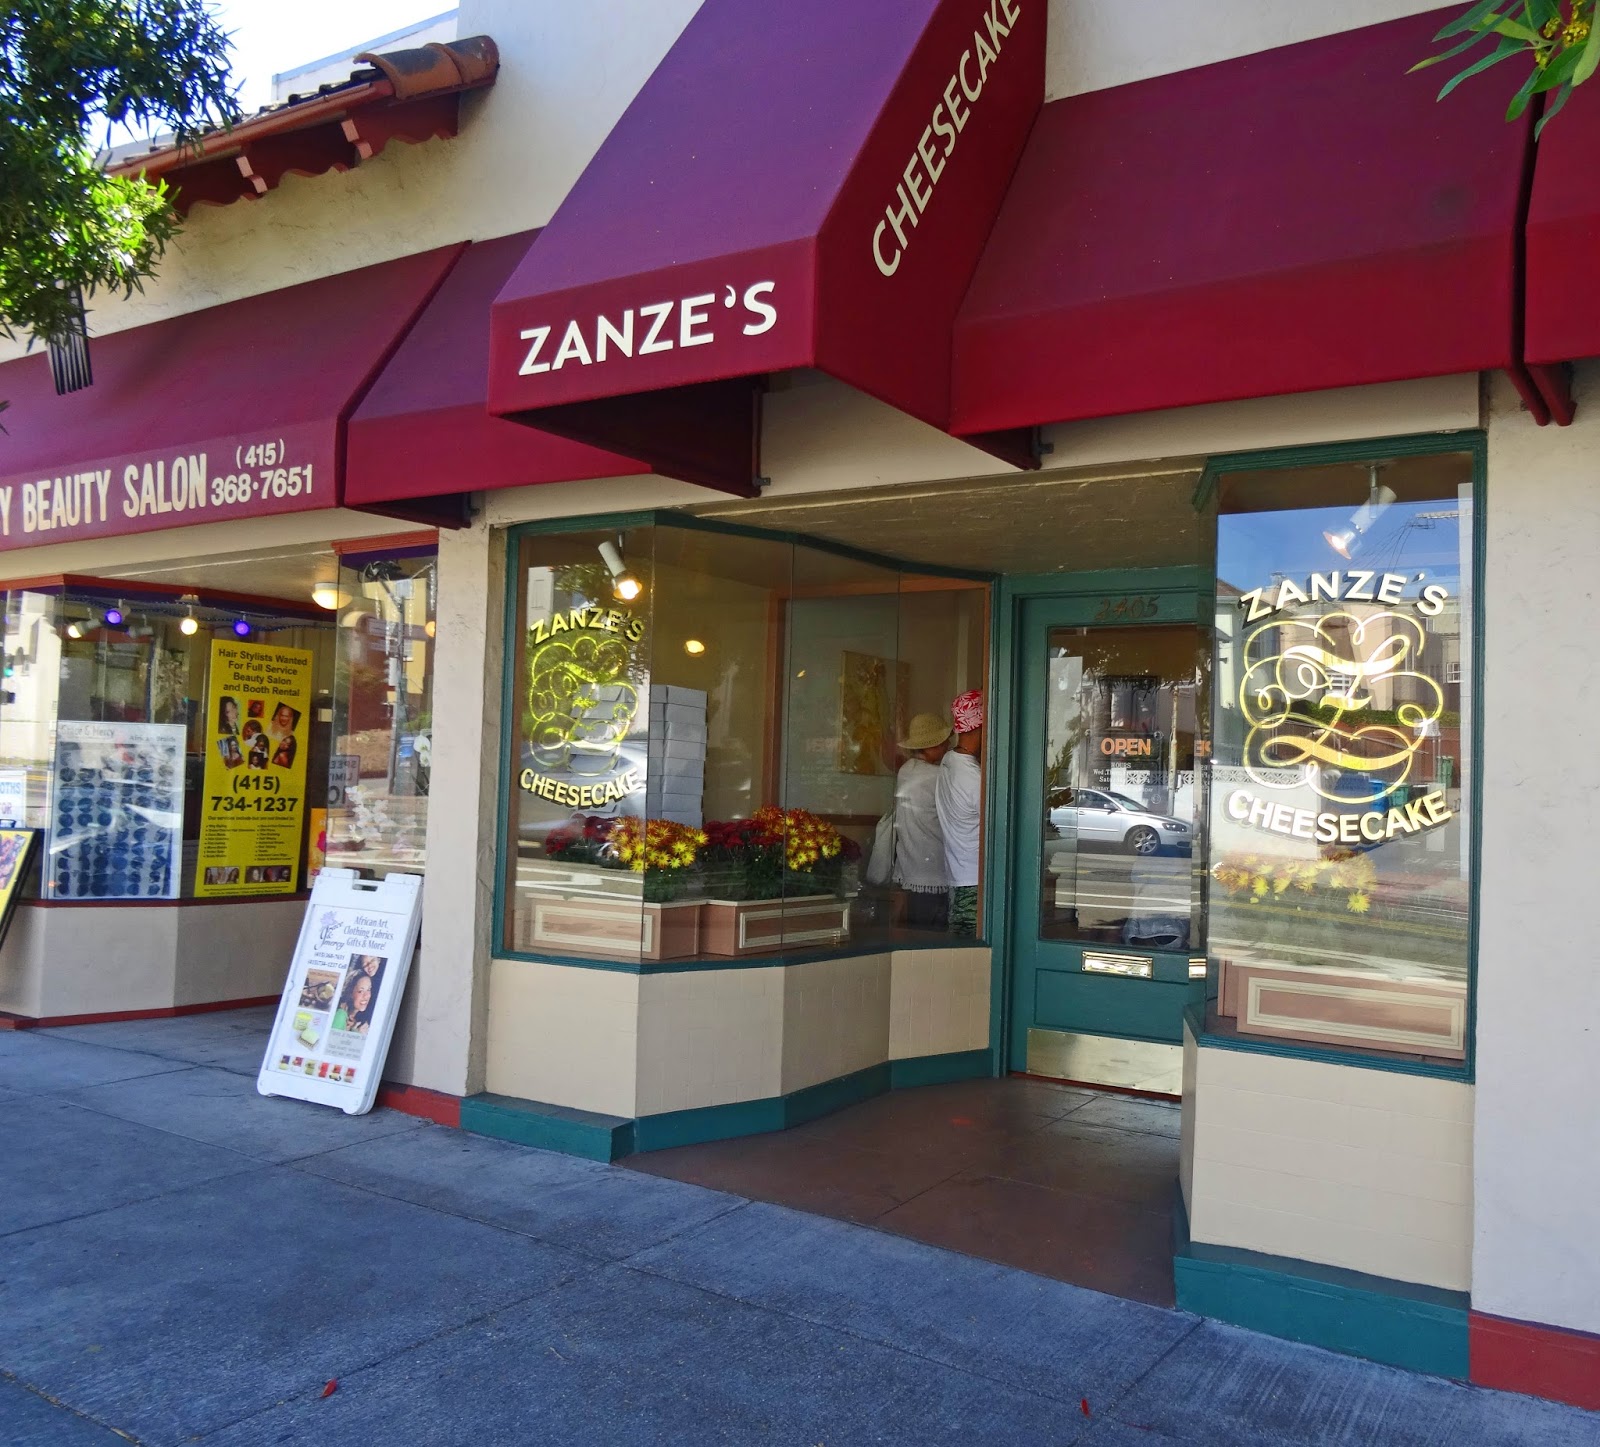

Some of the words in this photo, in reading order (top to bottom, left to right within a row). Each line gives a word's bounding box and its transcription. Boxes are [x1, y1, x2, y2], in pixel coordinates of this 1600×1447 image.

[519, 281, 777, 376] ZANZE'S
[235, 438, 286, 470] (415)
[0, 486, 13, 536] Y
[23, 469, 111, 533] BEAUTY
[124, 453, 207, 518] SALON
[1240, 570, 1450, 624] ZANZE'S
[530, 607, 646, 645] ZANZE'S
[218, 648, 238, 659] Hair
[239, 650, 273, 662] Stylists
[275, 654, 308, 666] Wanted
[228, 660, 244, 670] For
[246, 662, 263, 672] Full
[265, 664, 298, 676] Service
[233, 672, 265, 685] Beauty
[267, 674, 292, 685] Salon
[223, 683, 241, 692] and
[243, 684, 269, 694] Booth
[272, 687, 300, 697] Rental
[1101, 737, 1151, 755] OPEN
[232, 775, 281, 794] (415)
[520, 767, 642, 807] CHEESECAKE
[211, 796, 299, 812] 734-1237
[1228, 789, 1453, 843] CHEESECAKE
[354, 915, 378, 928] African
